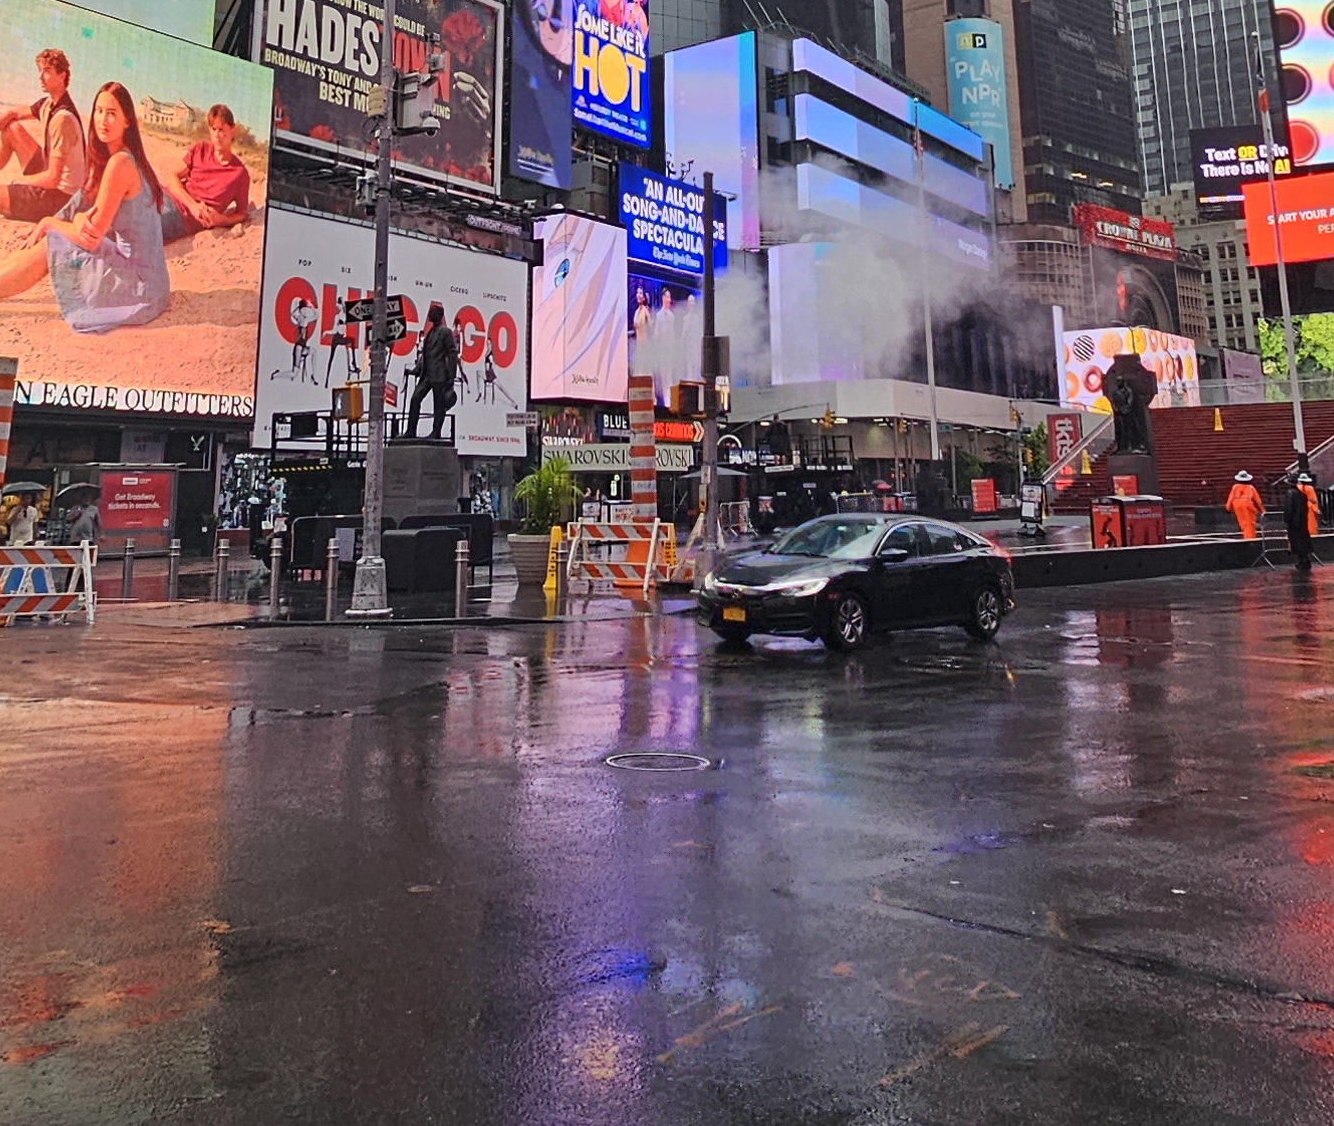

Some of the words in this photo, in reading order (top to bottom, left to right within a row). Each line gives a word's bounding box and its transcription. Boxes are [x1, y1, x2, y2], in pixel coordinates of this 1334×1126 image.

[393, 14, 415, 33] COULD
[415, 23, 426, 37] BE
[265, 48, 326, 79] BROADWAY'S
[327, 67, 352, 88] TONY
[353, 76, 371, 94] AND
[572, 29, 647, 114] HOT
[320, 81, 351, 108] BEST
[1204, 147, 1237, 162] Text
[1238, 145, 1258, 159] OR
[1200, 163, 1240, 178] There
[1240, 162, 1254, 175] Is
[623, 192, 725, 242] SONG-AND-DACE
[1299, 208, 1328, 221] YOUR
[633, 218, 705, 256] SPECTACULA
[1142, 230, 1173, 249] PLAZA
[298, 259, 313, 267] POP
[44, 382, 117, 410] EAGLE
[126, 388, 255, 418] OUTFITTERS
[603, 414, 628, 429] BLUE
[468, 435, 495, 444] BROADWAY
[496, 436, 509, 444] SINCE
[543, 447, 626, 466] SWAROVSKI
[108, 502, 128, 511] tickets
[128, 502, 135, 510] in
[115, 493, 127, 502] Get
[127, 492, 156, 503] Broadway
